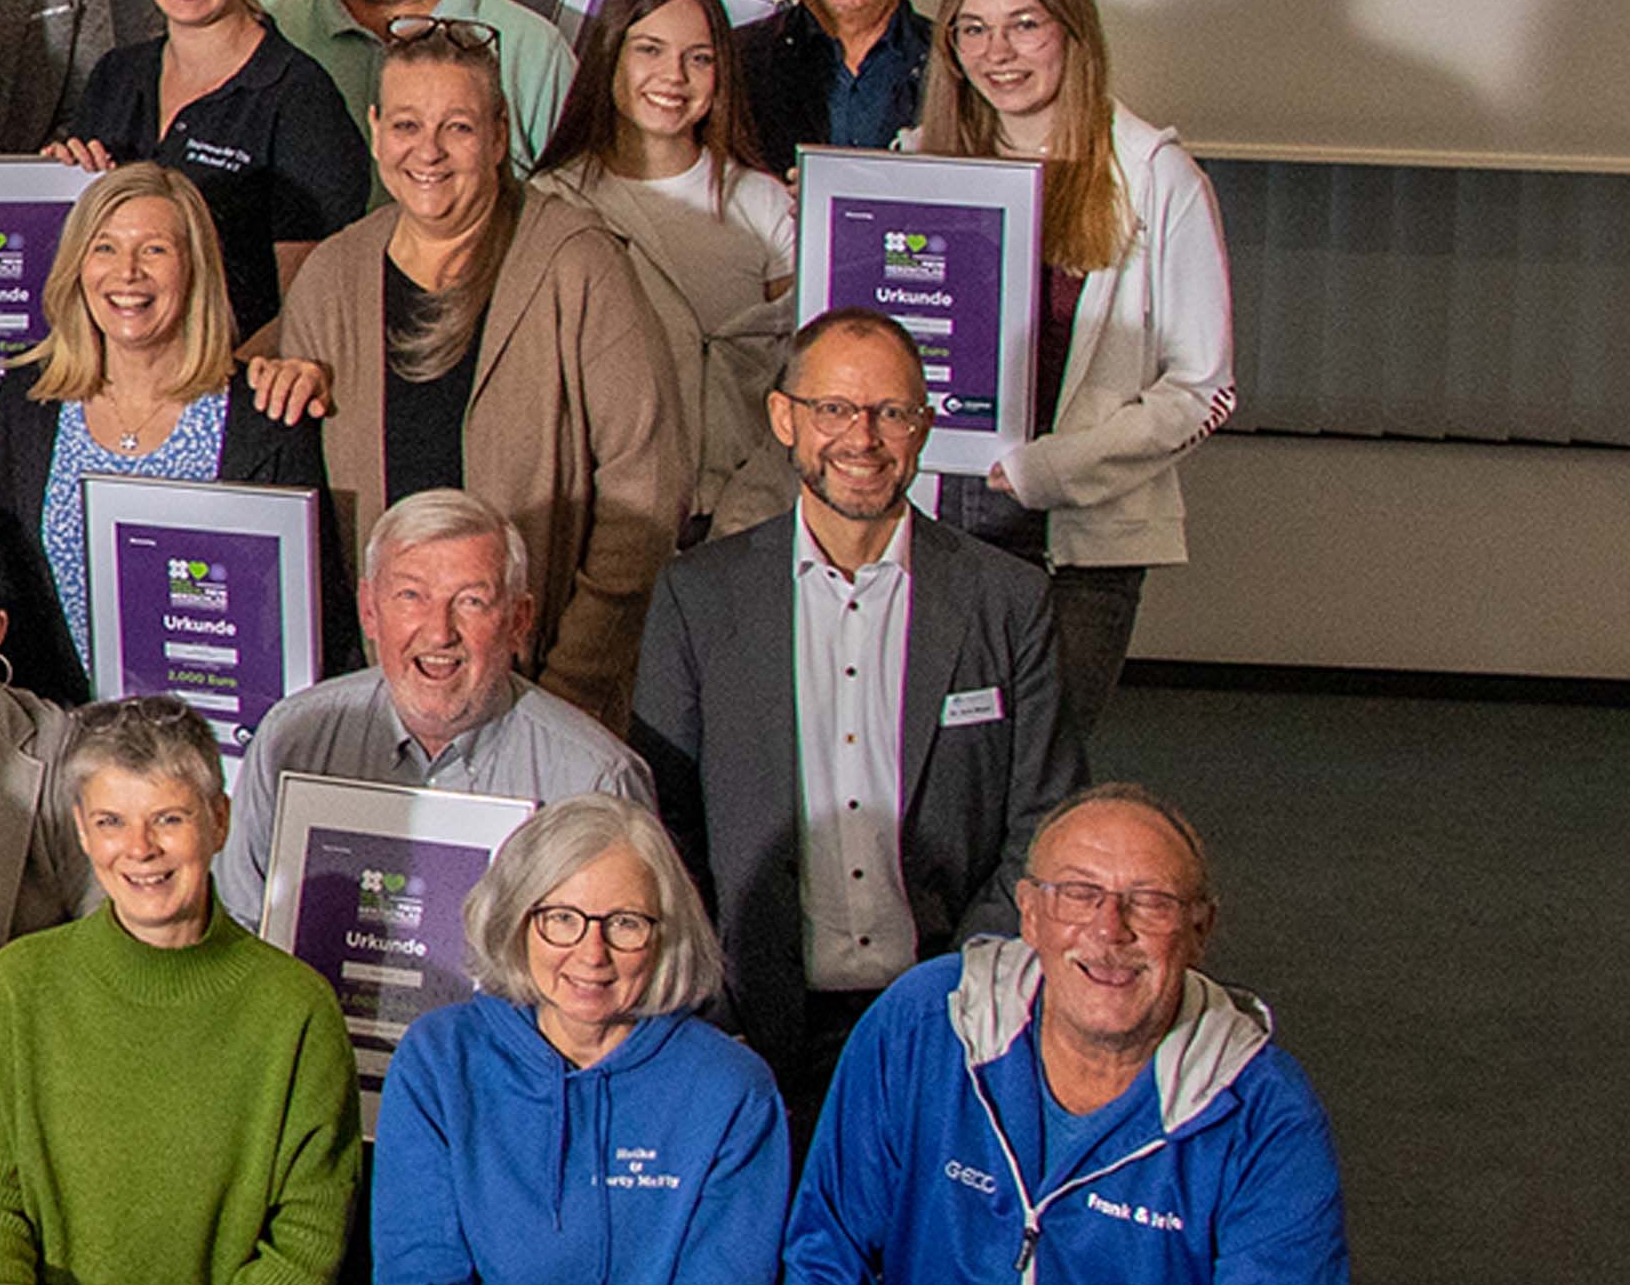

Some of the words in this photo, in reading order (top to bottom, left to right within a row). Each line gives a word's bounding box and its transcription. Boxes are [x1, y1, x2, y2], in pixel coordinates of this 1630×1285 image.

[876, 287, 952, 306] Urkunde
[163, 615, 236, 636] Urkunde
[346, 930, 427, 956] Urkunde
[1087, 1193, 1131, 1220] Frank
